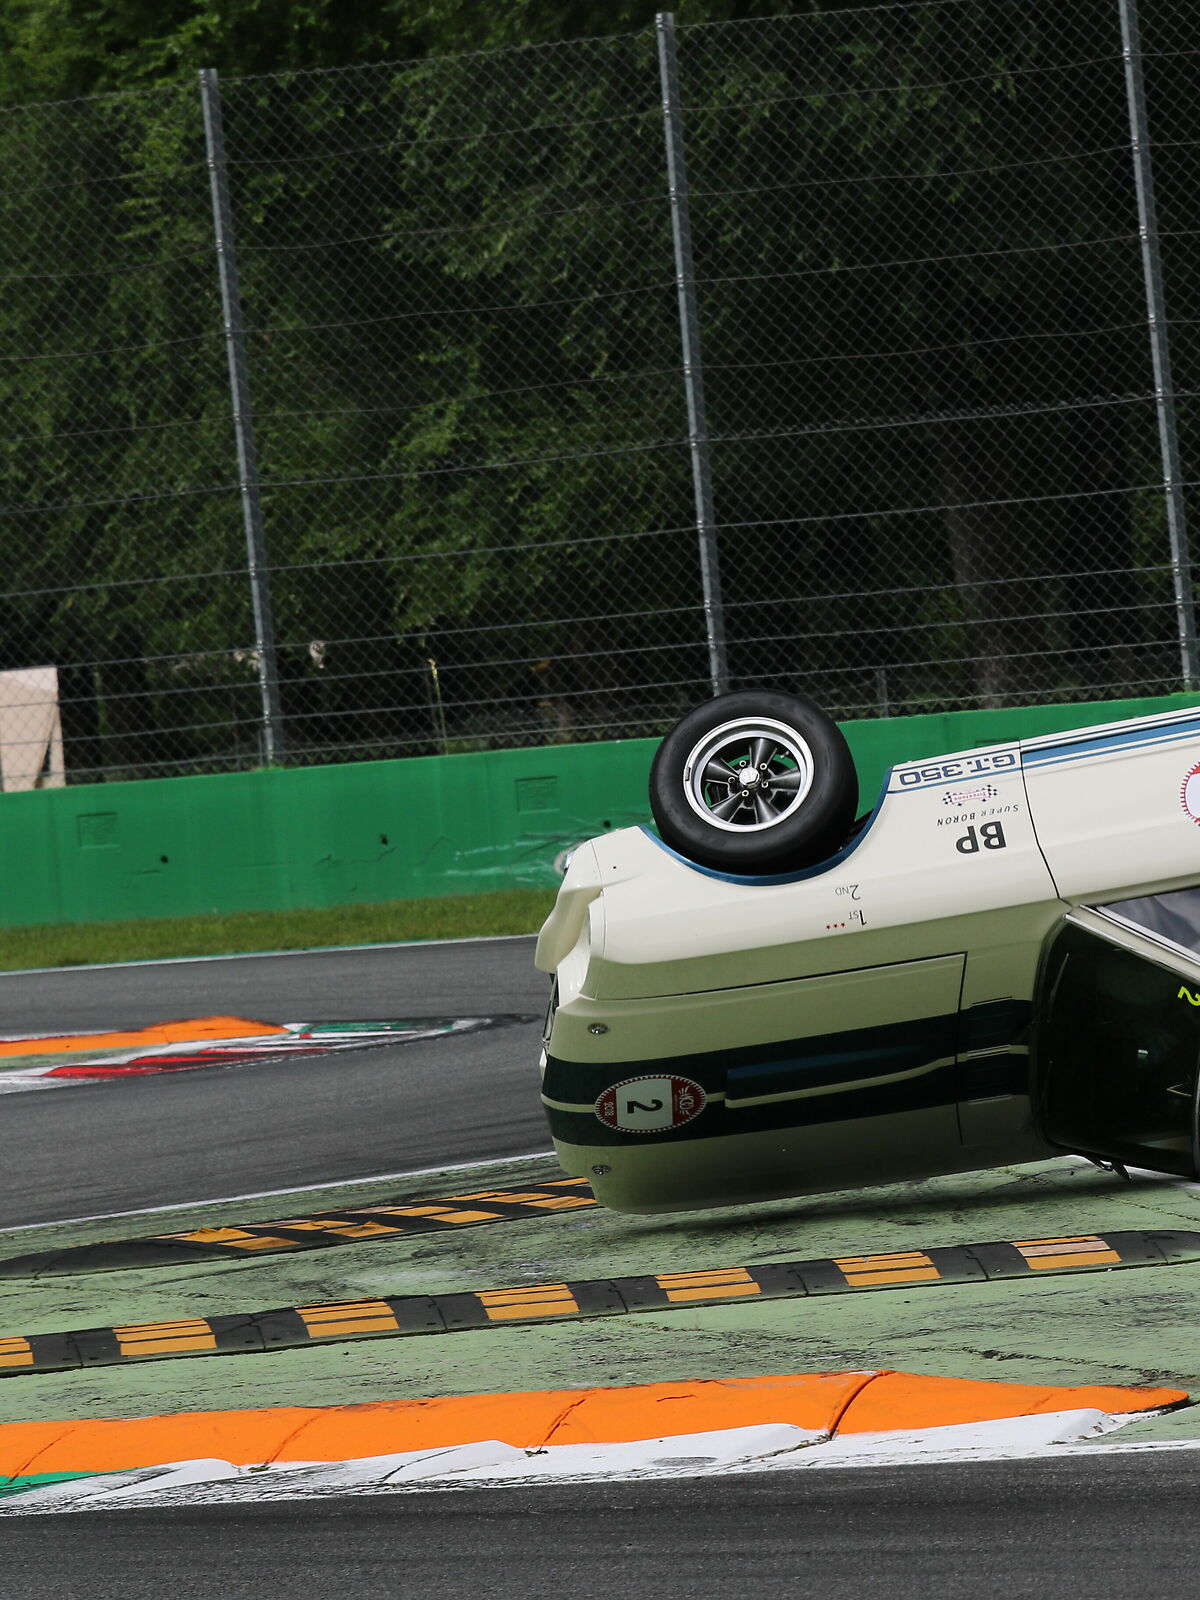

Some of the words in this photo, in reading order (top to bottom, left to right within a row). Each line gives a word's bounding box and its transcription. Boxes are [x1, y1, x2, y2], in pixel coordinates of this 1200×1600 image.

[935, 811, 976, 827] BORON
[980, 804, 1020, 818] SUPER
[955, 820, 1007, 855] BP
[835, 883, 862, 901] 2ND
[627, 1099, 664, 1114] 2
